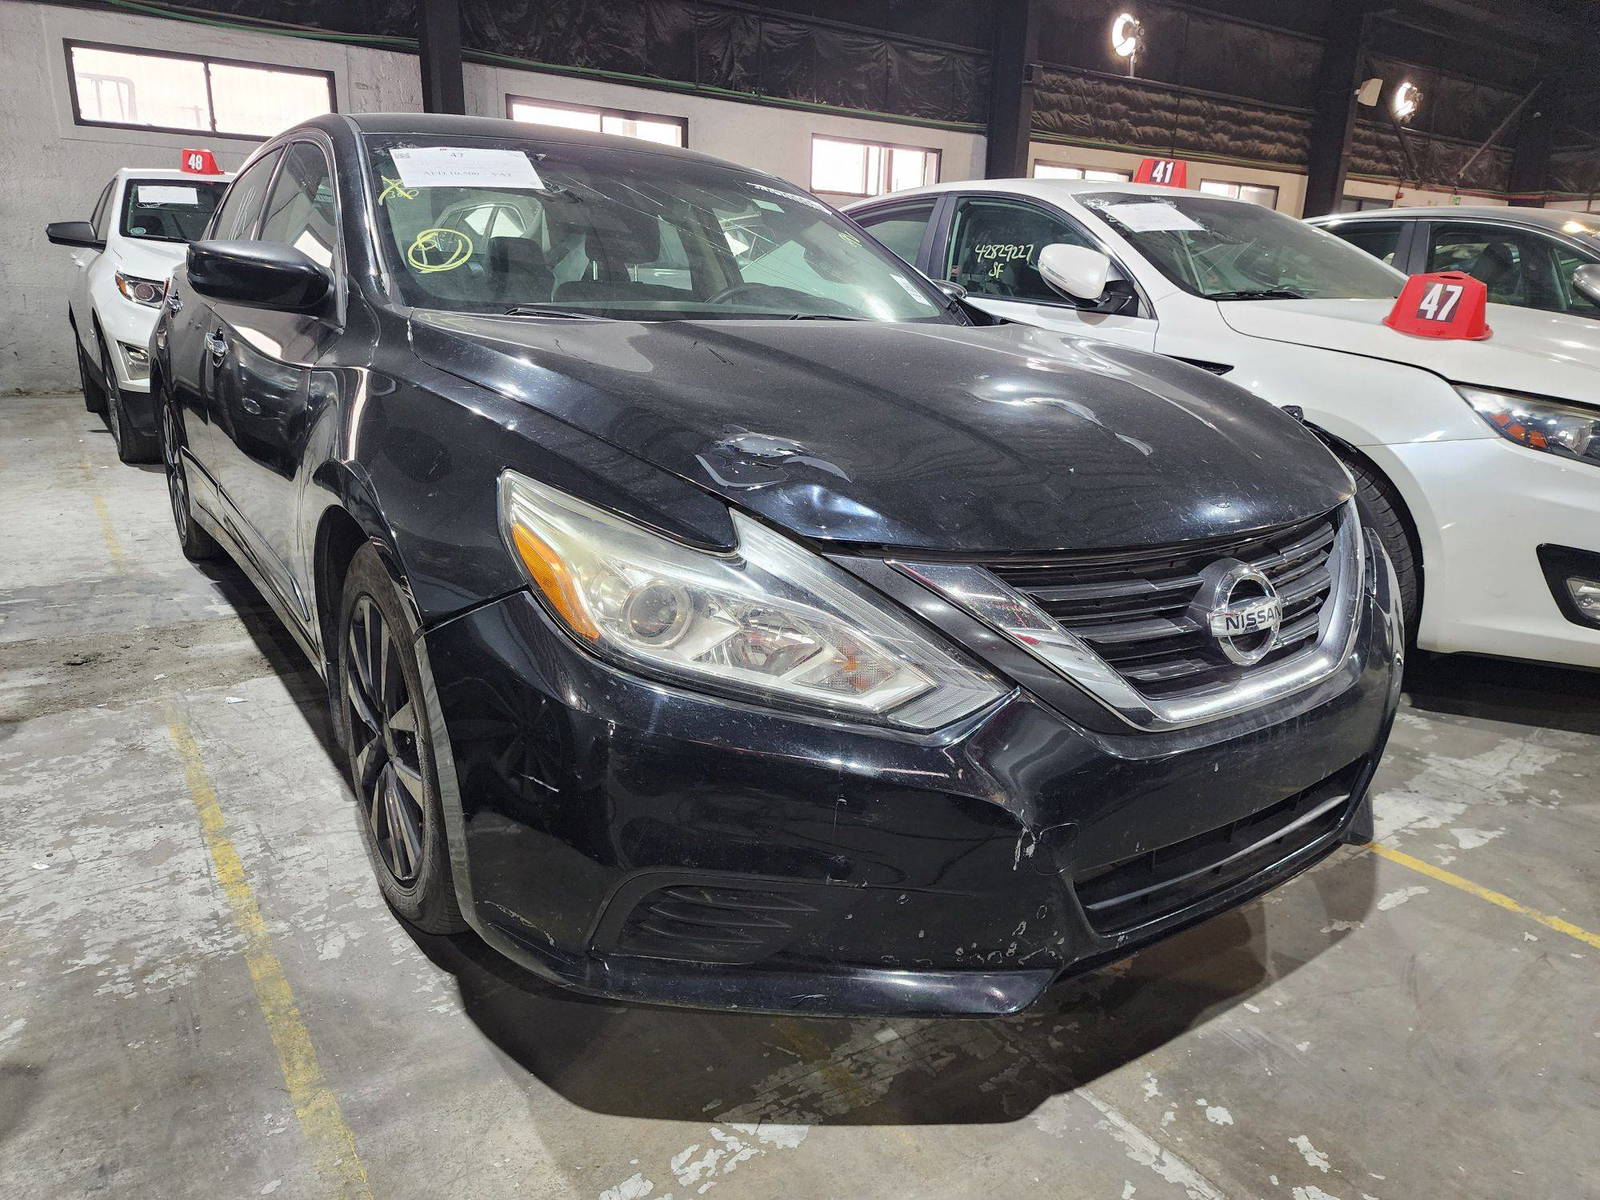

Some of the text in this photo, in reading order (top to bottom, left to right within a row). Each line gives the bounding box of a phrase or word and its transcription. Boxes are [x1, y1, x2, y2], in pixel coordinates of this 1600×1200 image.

[188, 153, 203, 171] 48
[1152, 160, 1175, 183] 41
[975, 244, 1034, 264] 42829227
[1420, 283, 1463, 320] 47
[1225, 605, 1281, 631] NISSAN
